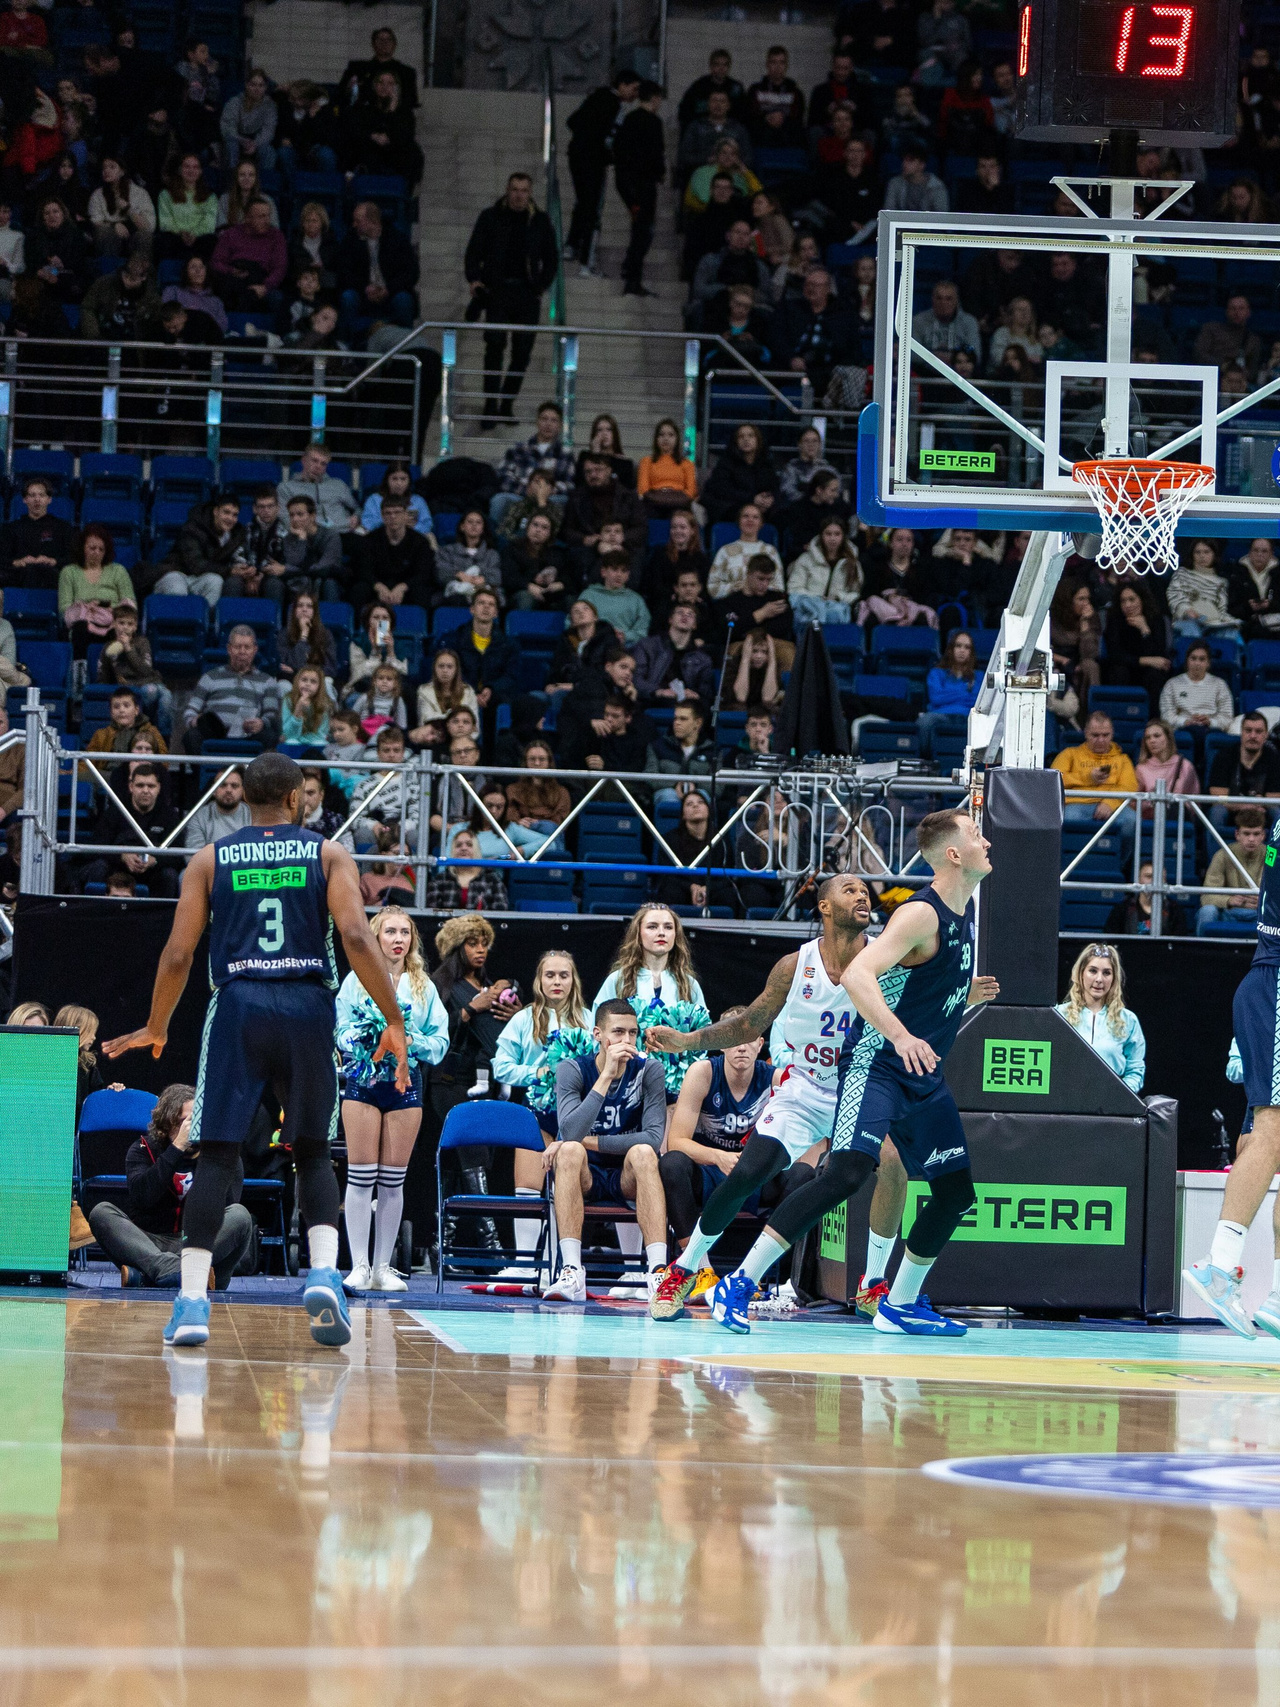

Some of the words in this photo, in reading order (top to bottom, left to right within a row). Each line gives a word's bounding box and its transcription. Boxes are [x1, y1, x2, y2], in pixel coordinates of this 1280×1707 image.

[1116, 7, 1193, 76] 13
[219, 840, 319, 864] OGUNGBEMI
[258, 898, 285, 952] 3
[820, 1011, 850, 1037] 24
[992, 1047, 1044, 1065] BET
[603, 1104, 621, 1129] 31
[724, 1113, 749, 1134] 99
[861, 1131, 882, 1145] Kempa
